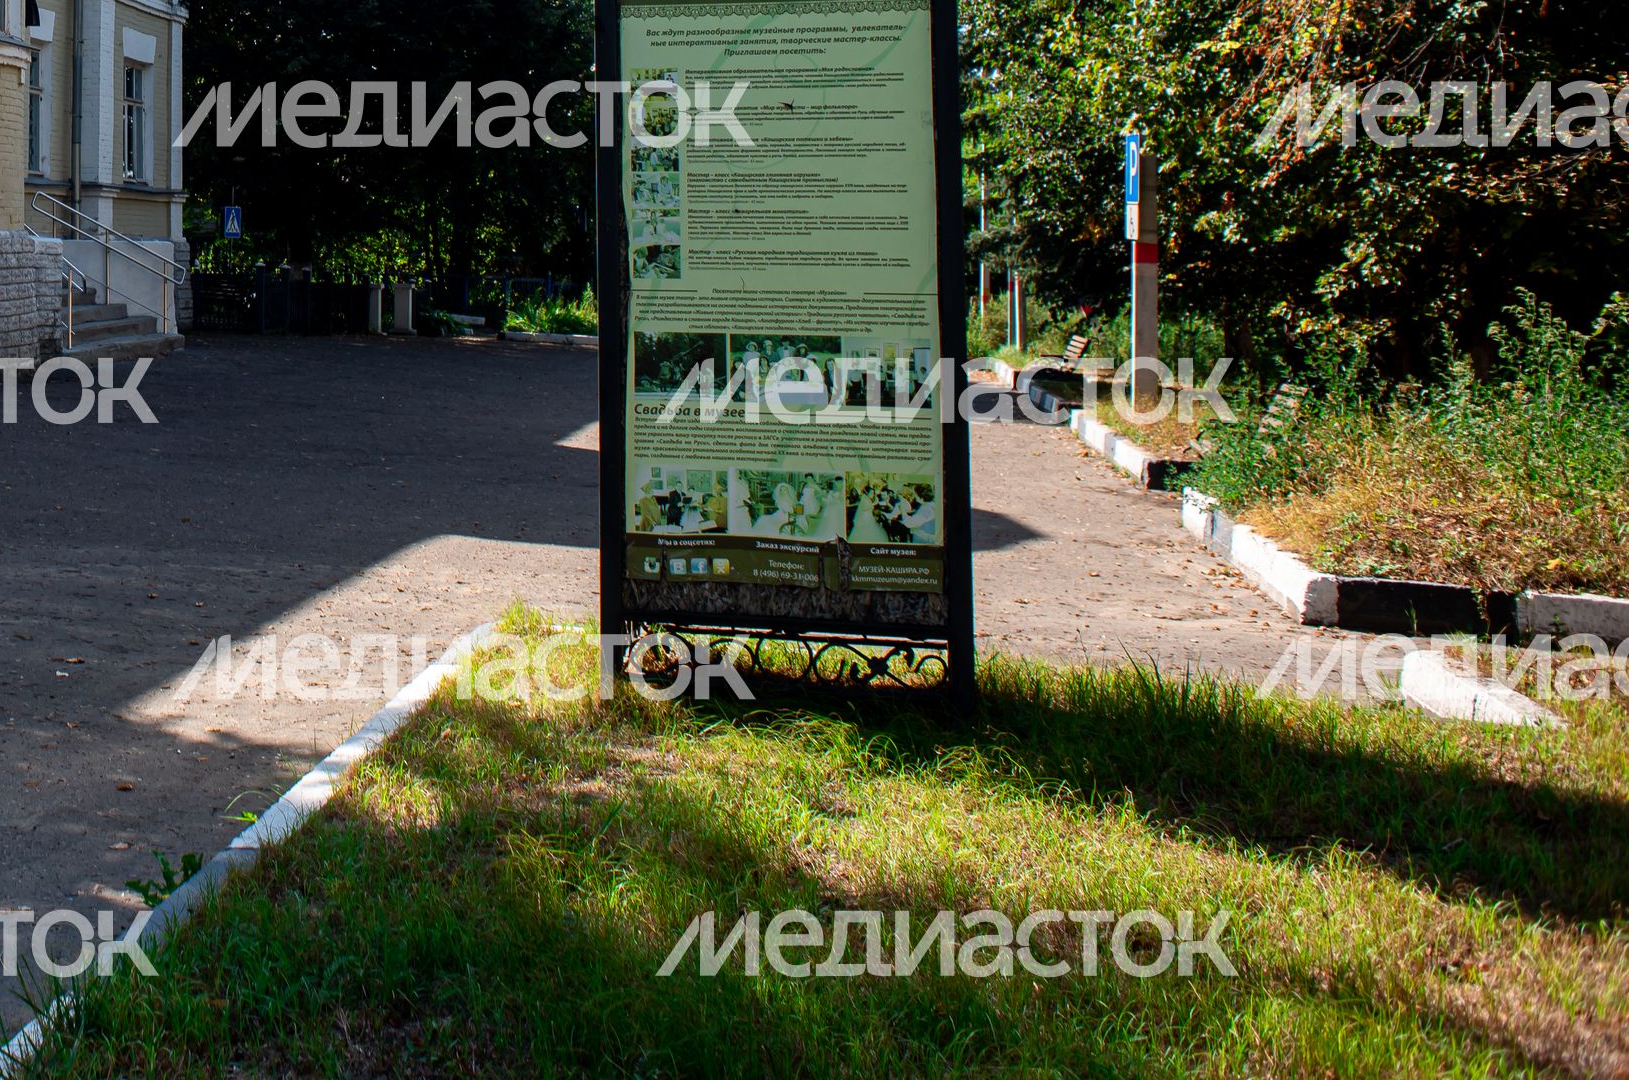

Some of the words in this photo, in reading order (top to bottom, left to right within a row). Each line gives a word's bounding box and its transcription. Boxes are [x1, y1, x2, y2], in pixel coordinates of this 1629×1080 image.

[660, 28, 685, 37] ждут
[685, 27, 751, 36] разнообразные
[752, 26, 795, 35] музейные
[795, 26, 847, 34] программы,
[851, 24, 907, 32] увлекатель-
[667, 39, 738, 47] интерактивные
[739, 38, 779, 46] занятия,
[779, 37, 832, 45] творческие
[832, 35, 902, 44] мастер-классы.
[724, 48, 778, 57] Приглашаем
[1130, 142, 1138, 195] P
[634, 403, 691, 416] Свадьба
[694, 408, 701, 416] в
[704, 408, 746, 419] музее
[679, 539, 716, 547] соцсетях:
[756, 541, 778, 549] Заказ
[870, 547, 889, 556] Сайт
[890, 549, 917, 557] музея:
[768, 559, 804, 570] Телефон:
[760, 570, 779, 578] (496)
[858, 565, 930, 575] МУЗЕЙ-КАШИРА.РФ
